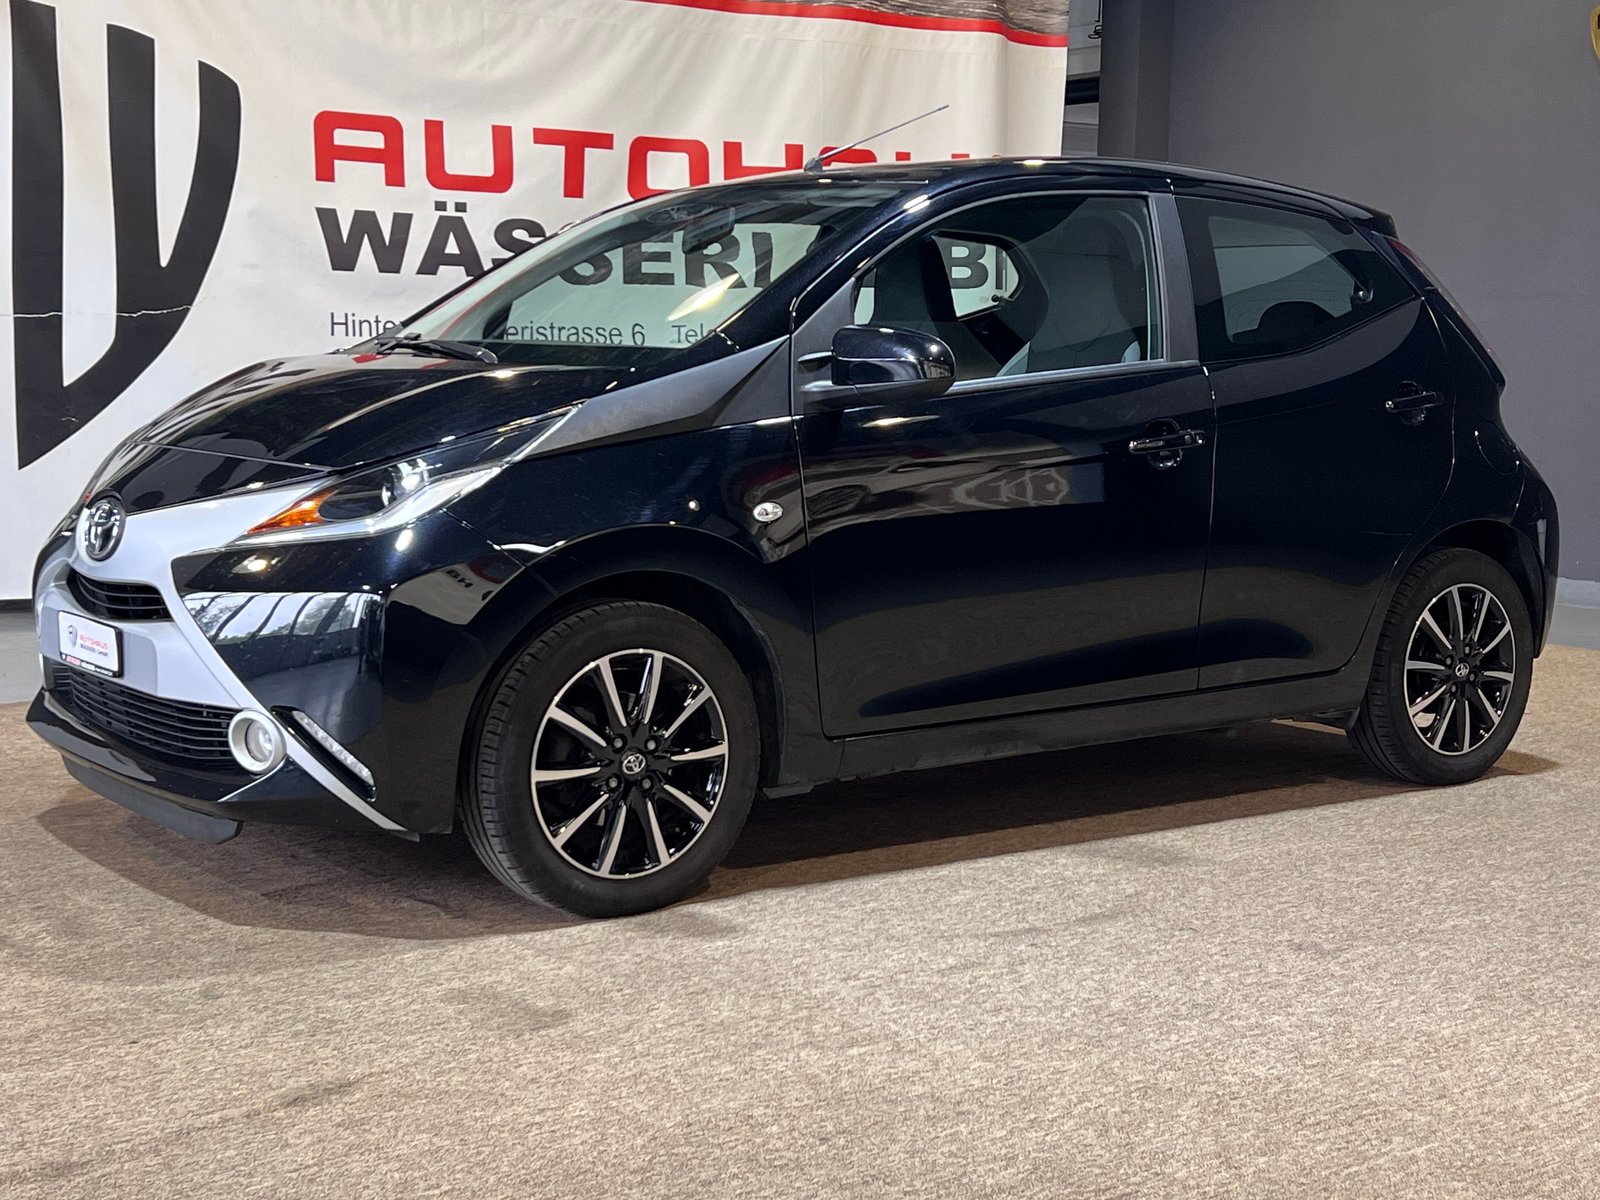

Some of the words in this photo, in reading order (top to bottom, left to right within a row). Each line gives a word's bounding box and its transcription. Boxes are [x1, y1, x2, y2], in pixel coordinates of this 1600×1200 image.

[313, 110, 1000, 200] AUTOH
[631, 323, 646, 346] 6
[671, 322, 714, 344] Tel
